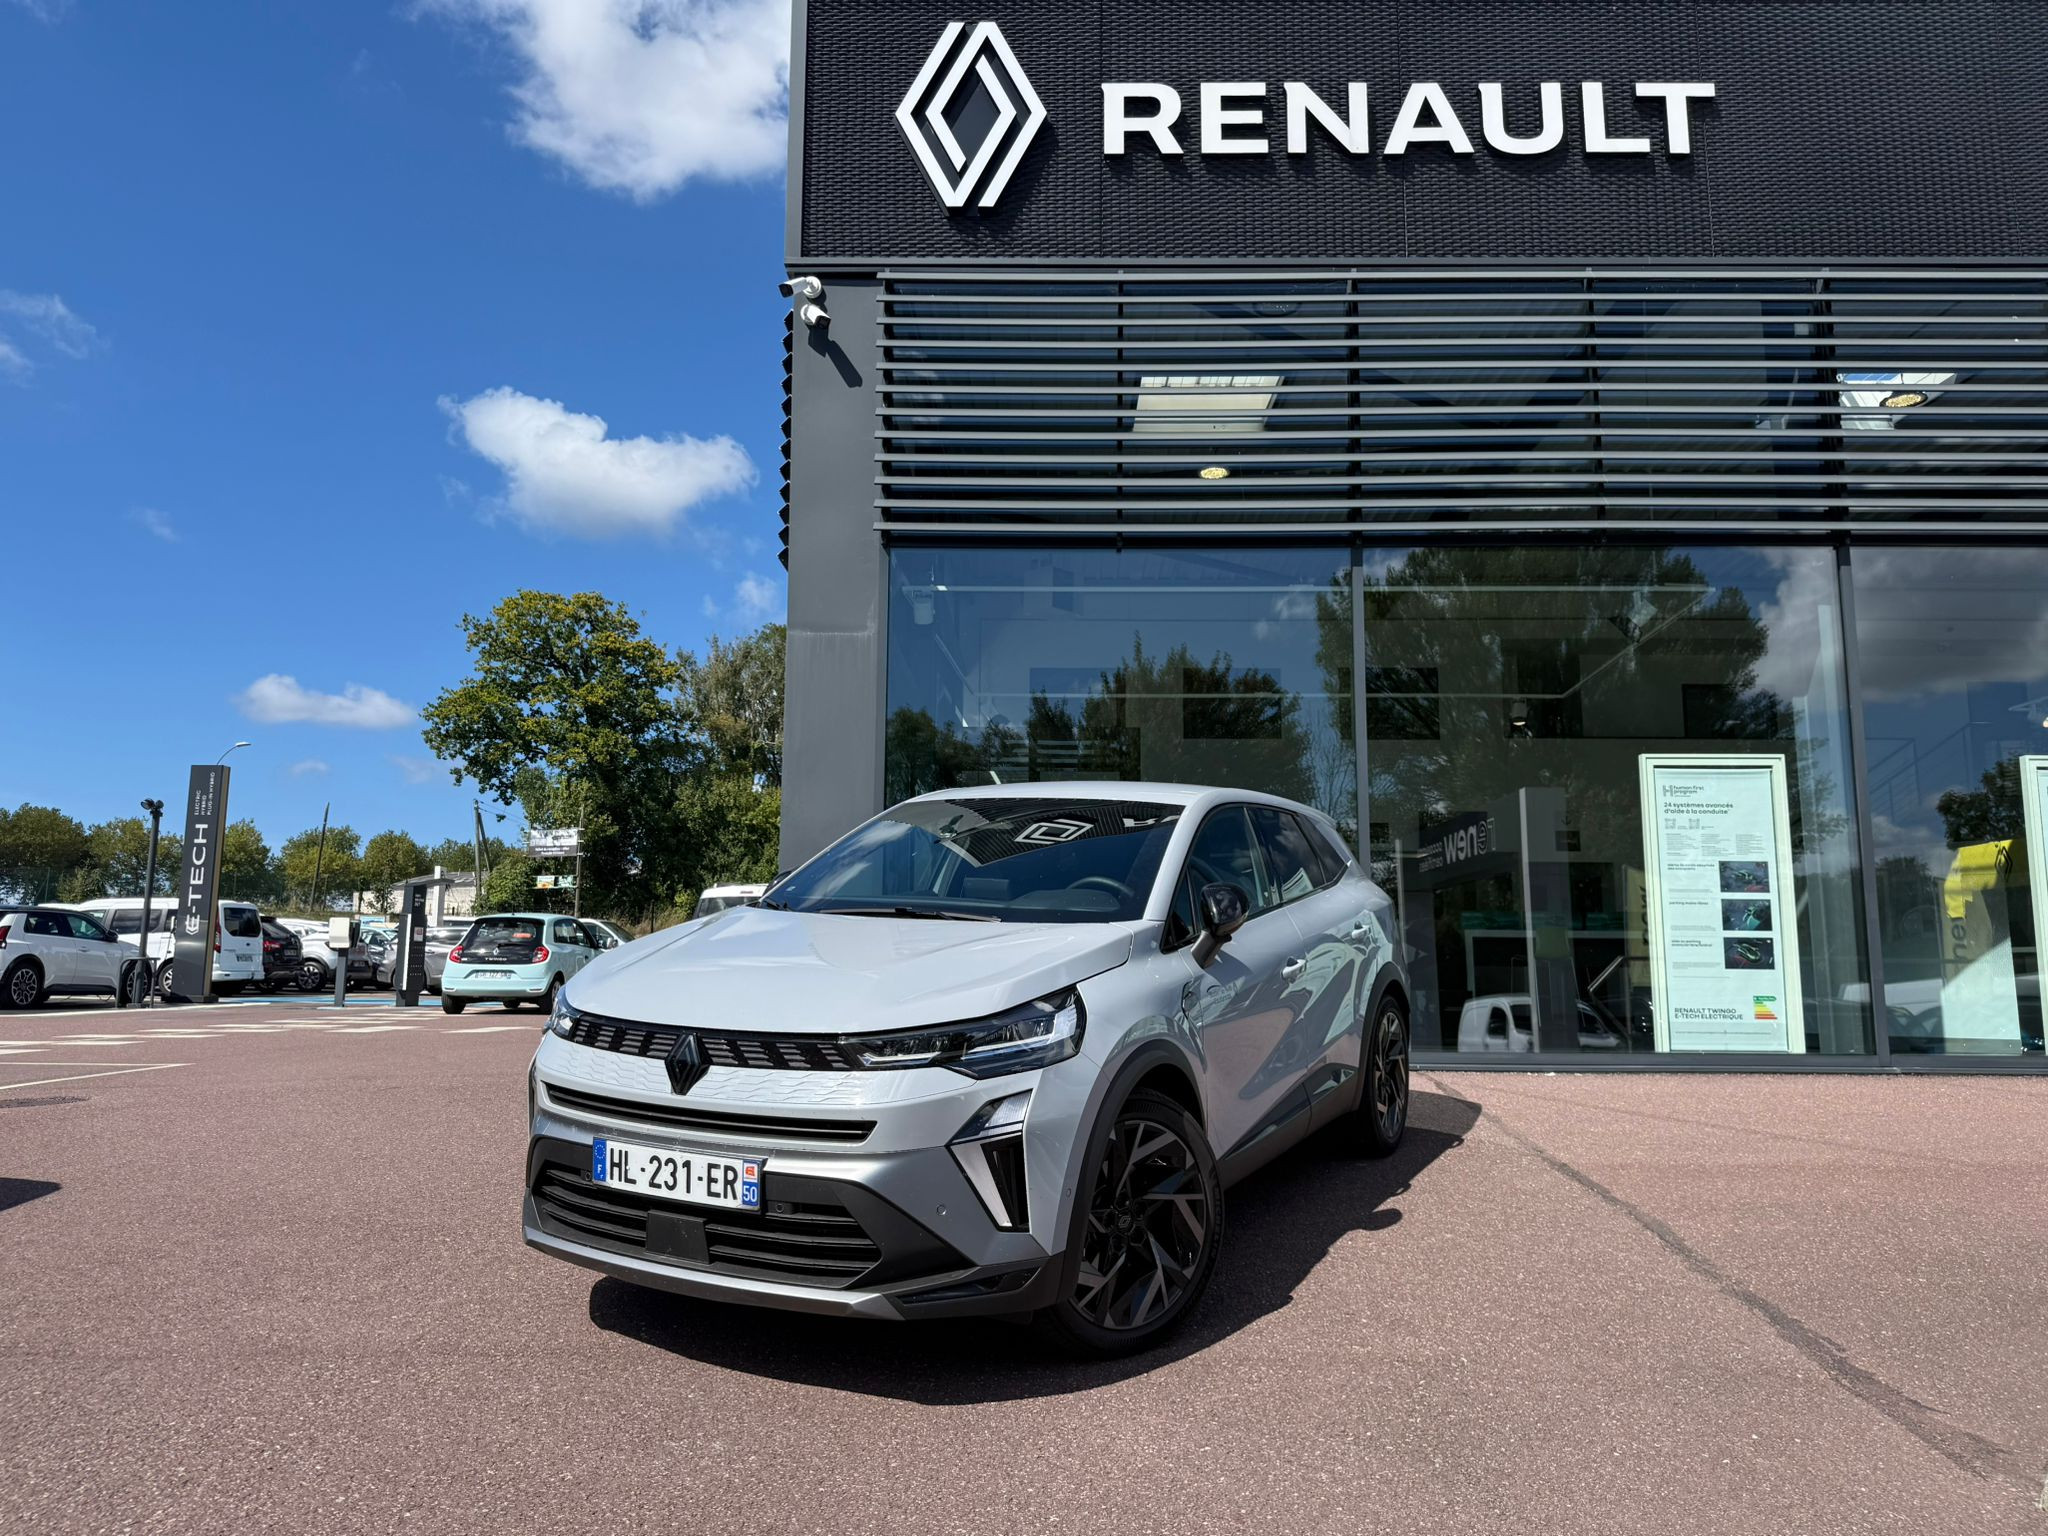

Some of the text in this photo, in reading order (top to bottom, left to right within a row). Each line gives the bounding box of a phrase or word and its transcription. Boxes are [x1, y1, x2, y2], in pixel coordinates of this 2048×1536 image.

[1101, 82, 1716, 155] RENAULT
[185, 823, 208, 936] E-TECH
[743, 1186, 757, 1202] 50
